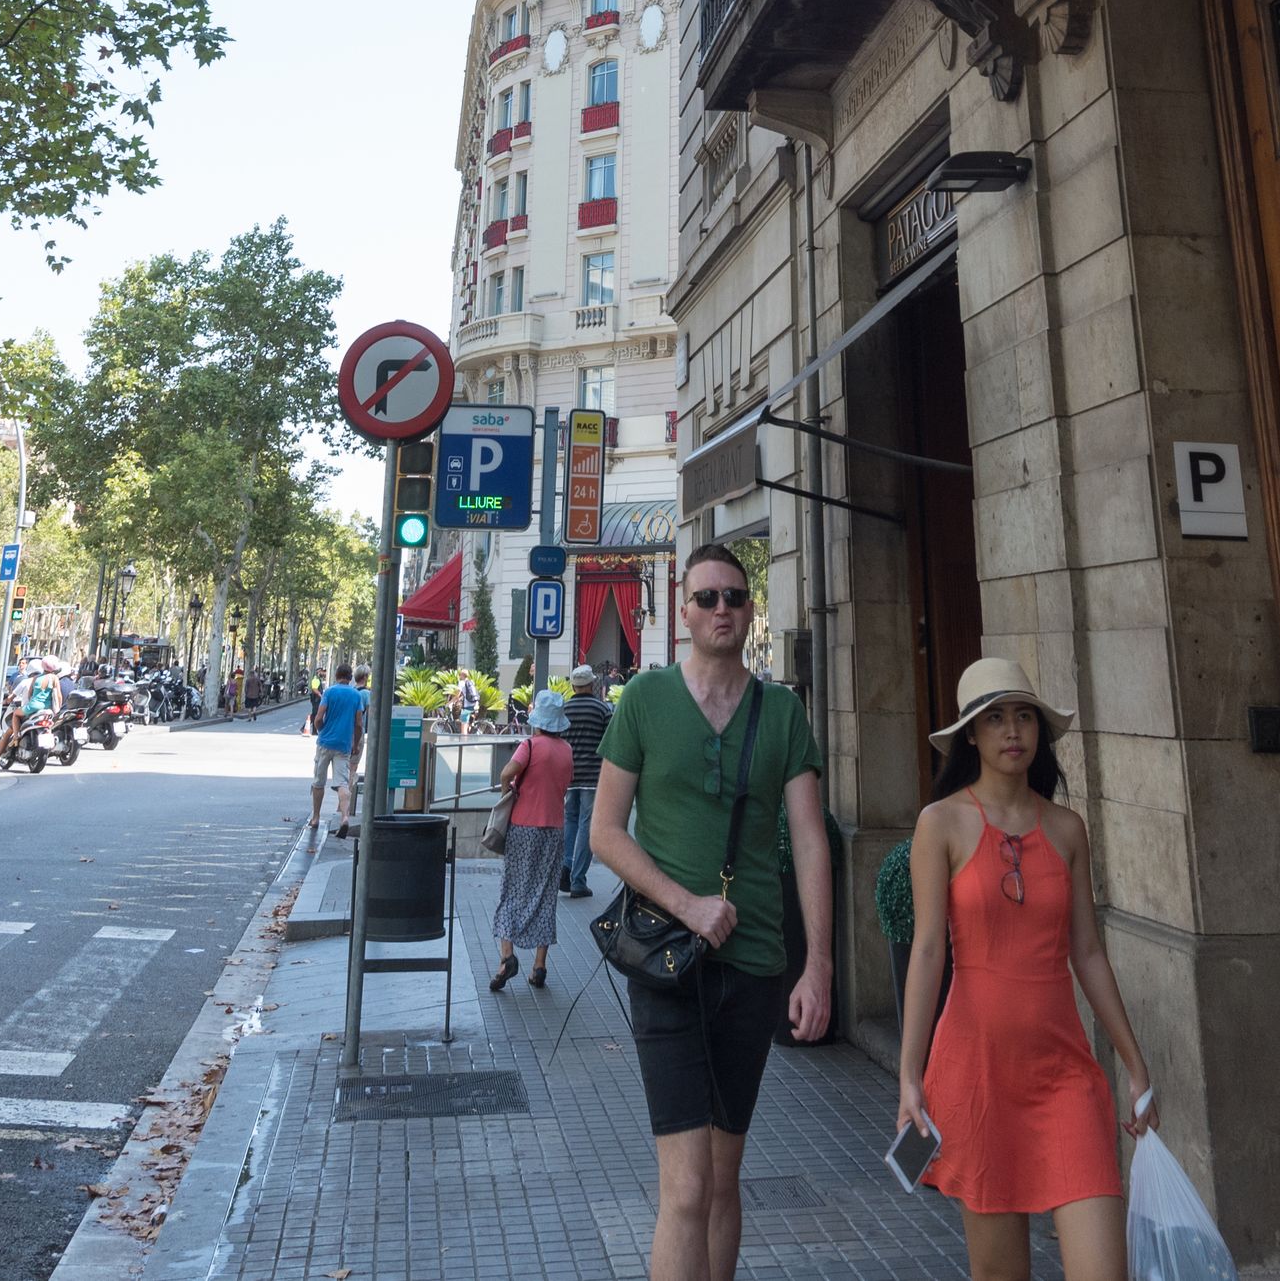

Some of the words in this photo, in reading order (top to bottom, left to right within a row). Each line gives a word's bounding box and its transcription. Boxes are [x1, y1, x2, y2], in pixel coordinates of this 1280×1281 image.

[910, 237, 928, 259] WINE
[472, 412, 504, 426] saba
[576, 422, 598, 430] RACC
[470, 438, 503, 491] P
[1189, 451, 1226, 502] P
[574, 485, 586, 499] 24
[589, 488, 596, 499] h
[459, 496, 502, 509] LLIURE
[536, 587, 557, 629] P
